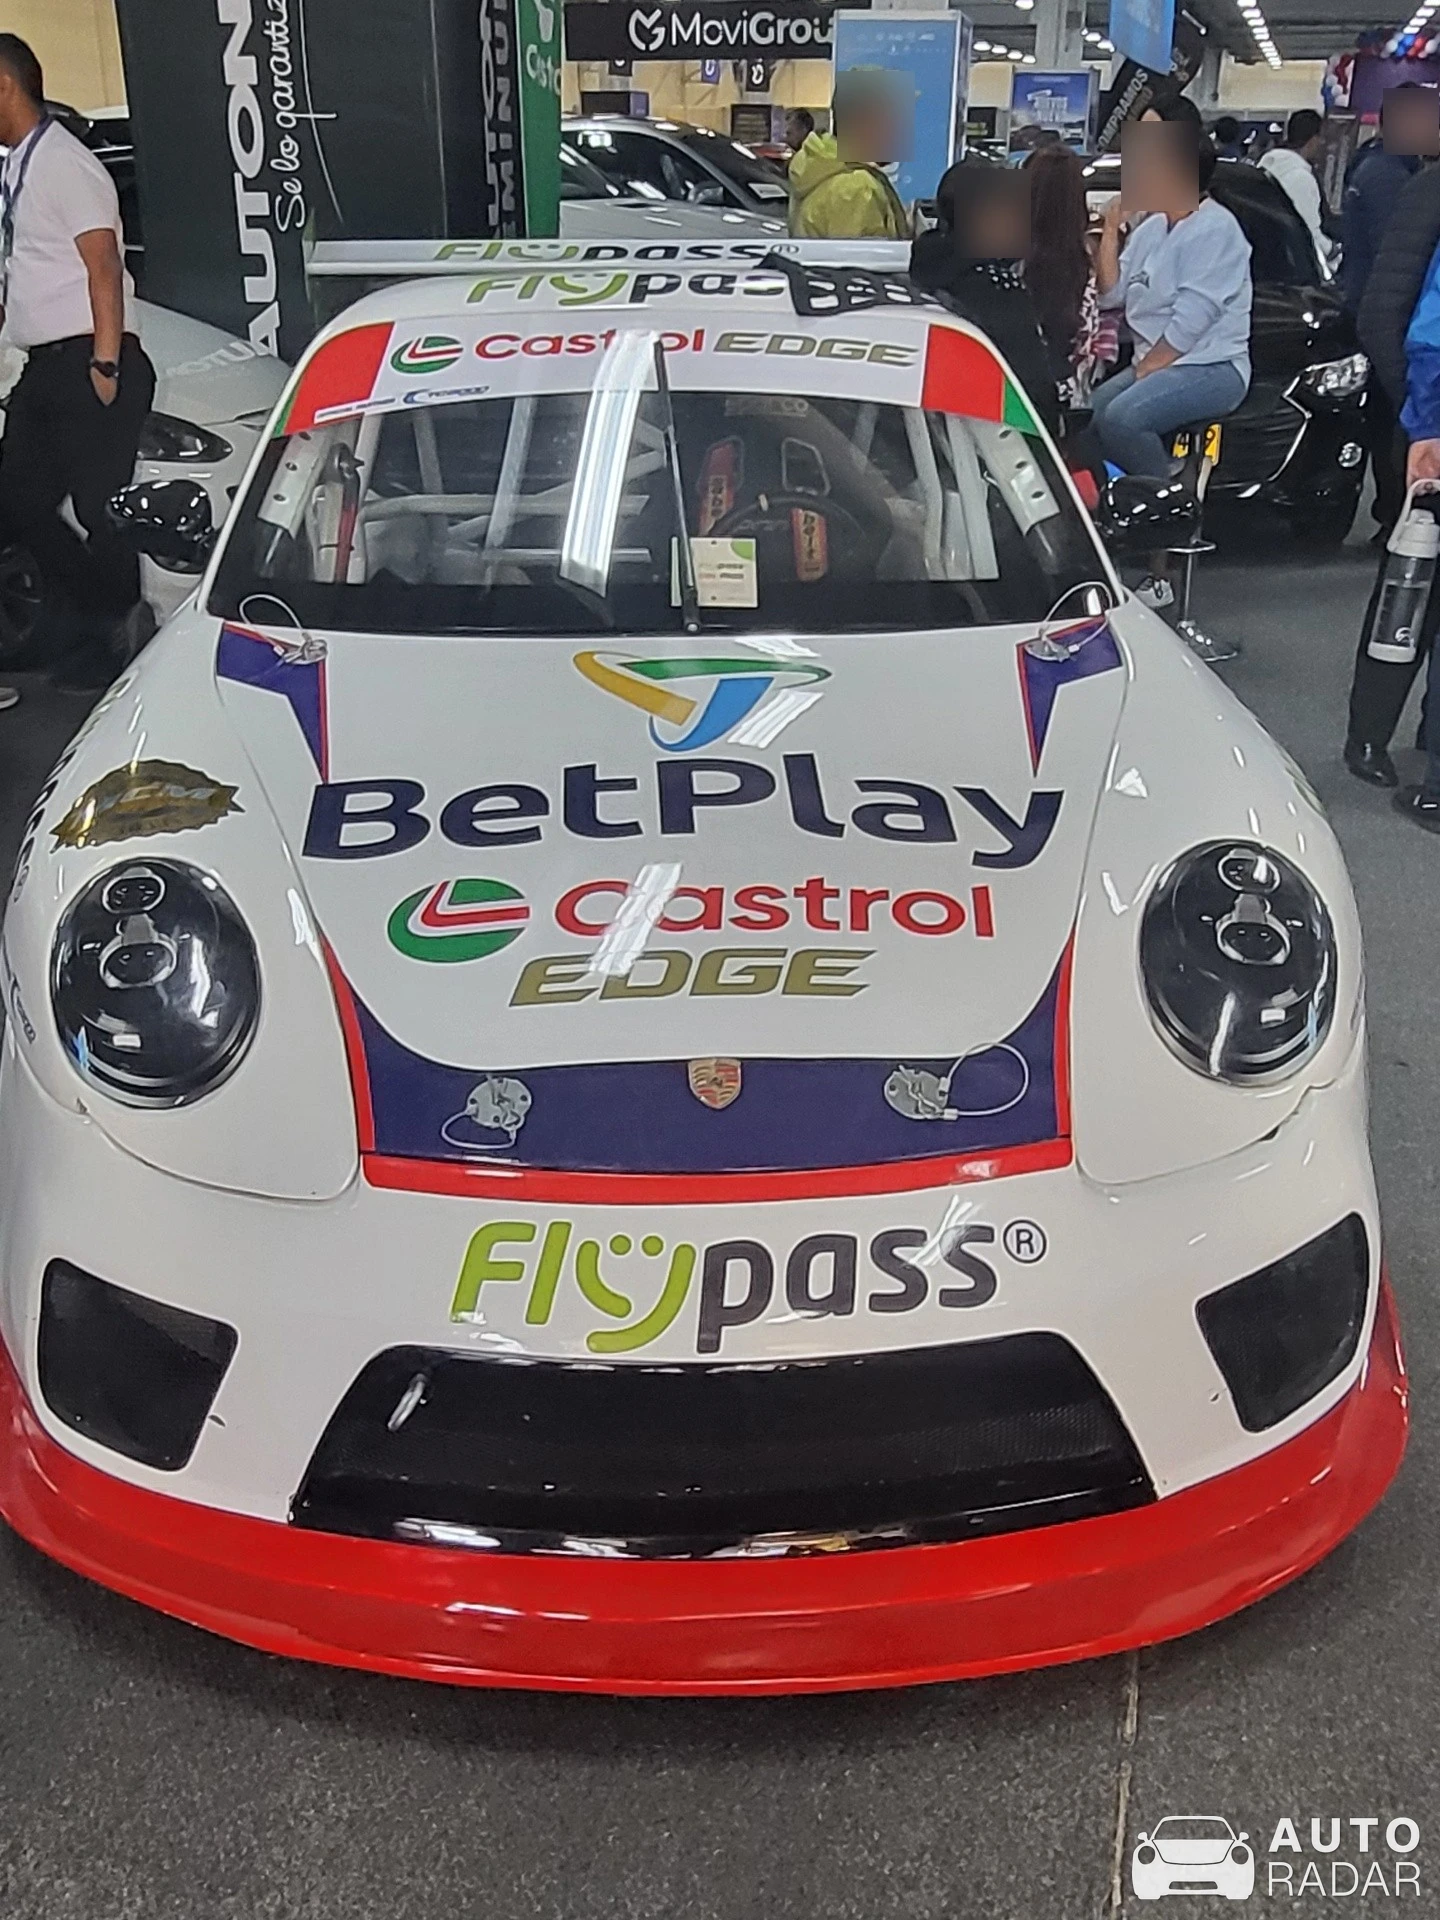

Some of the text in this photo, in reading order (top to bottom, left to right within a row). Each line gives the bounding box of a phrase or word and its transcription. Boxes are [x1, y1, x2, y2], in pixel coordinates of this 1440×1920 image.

[270, 133, 300, 173] lo
[274, 178, 306, 232] Se
[713, 332, 919, 367] EDGE
[301, 752, 1066, 869] BetPlay
[554, 874, 997, 940] Castrol
[509, 947, 877, 1007] EDGE
